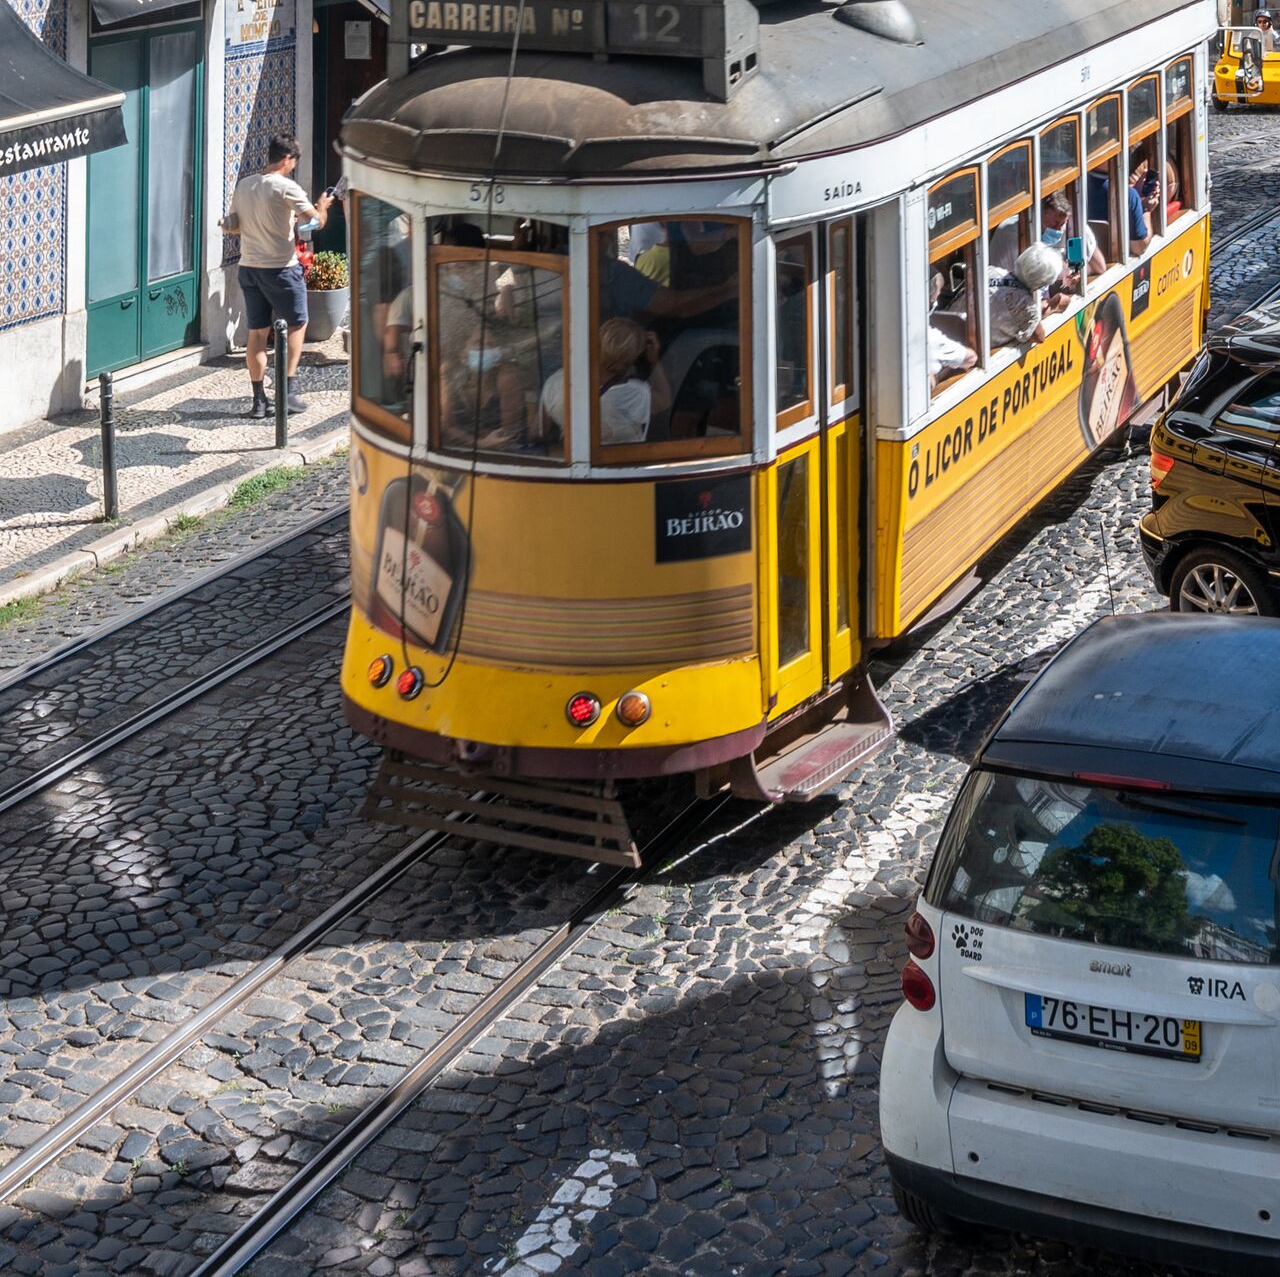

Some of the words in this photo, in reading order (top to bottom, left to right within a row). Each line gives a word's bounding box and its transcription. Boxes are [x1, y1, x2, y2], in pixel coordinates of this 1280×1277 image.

[409, 0, 536, 35] CARREIRA
[632, 4, 681, 43] 12
[469, 183, 506, 204] 578
[824, 180, 862, 201] SAÍDA
[908, 460, 920, 499] O
[925, 417, 973, 487] LICOR
[978, 396, 999, 444] DE
[1002, 339, 1074, 425] PORTUGAL
[666, 511, 744, 537] BEIRÃO
[970, 926, 984, 937] DOG
[973, 939, 983, 949] ON
[960, 949, 982, 961] BOARD
[1089, 959, 1132, 978] smart
[1208, 978, 1247, 1001] IRA
[1184, 1020, 1198, 1031] 07
[1184, 1040, 1198, 1052] 09
